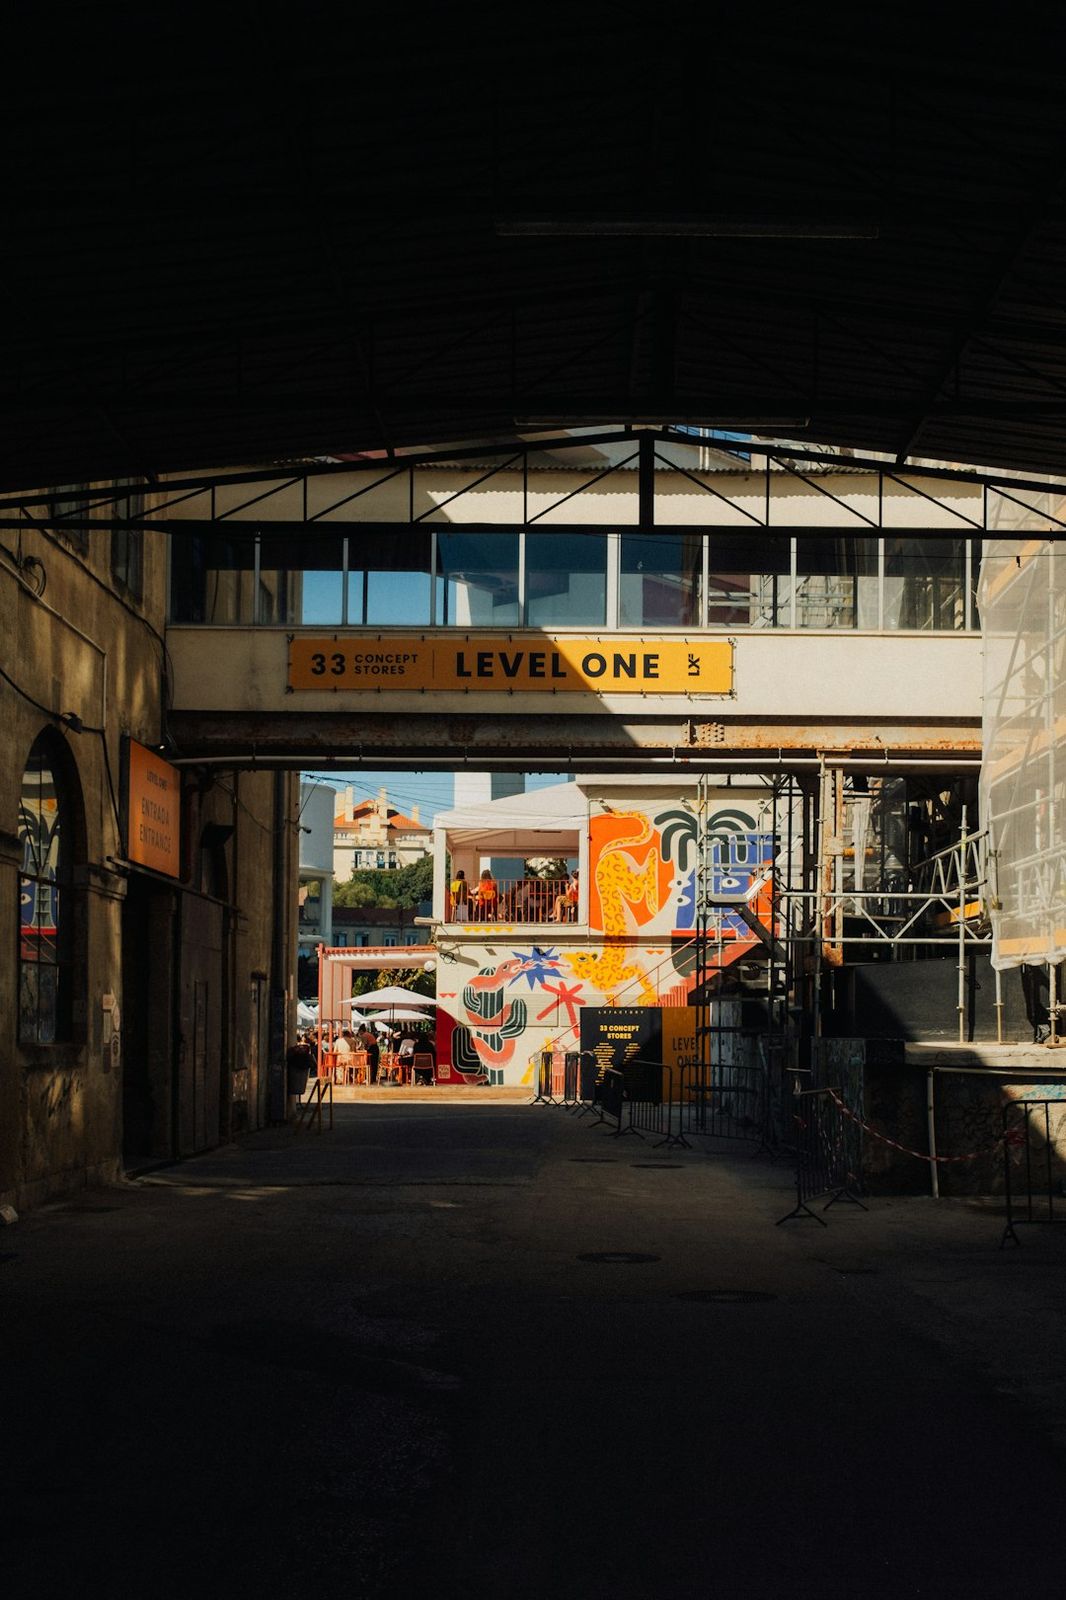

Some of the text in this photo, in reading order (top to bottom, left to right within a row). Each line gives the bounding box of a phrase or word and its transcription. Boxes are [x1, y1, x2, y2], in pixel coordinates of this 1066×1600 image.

[311, 653, 419, 676] 33 CONCEPT
[354, 664, 406, 676] STORES
[456, 652, 660, 679] LEVEL ONE
[141, 797, 169, 825] ENTRADA
[139, 824, 171, 854] ENTRANCE
[672, 1037, 700, 1051] LEVE
